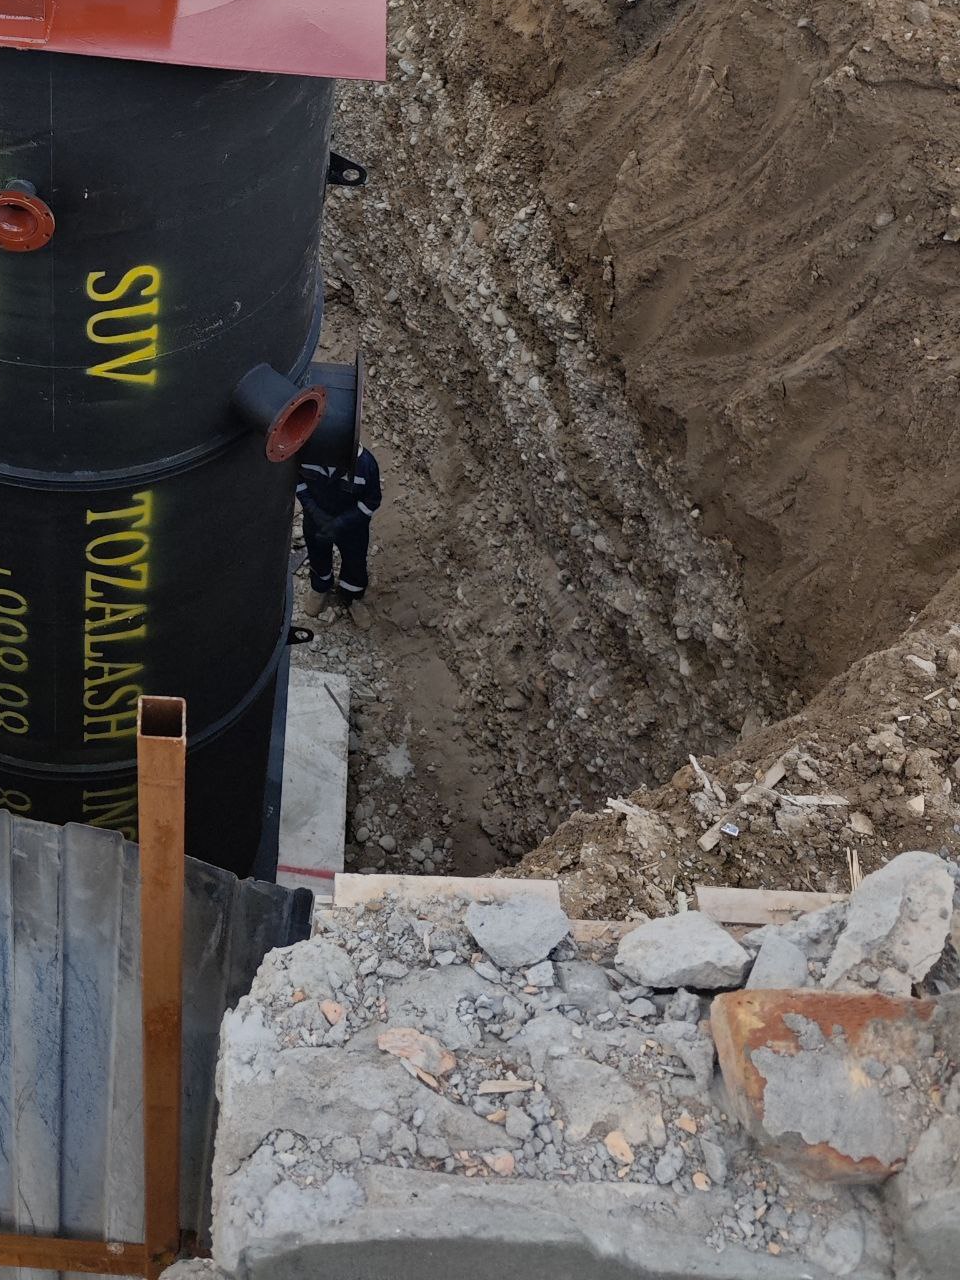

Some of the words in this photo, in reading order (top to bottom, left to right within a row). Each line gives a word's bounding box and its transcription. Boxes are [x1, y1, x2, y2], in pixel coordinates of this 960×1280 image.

[85, 264, 161, 386] SUV
[83, 490, 154, 743] TOZALASH
[82, 784, 138, 842] IN
